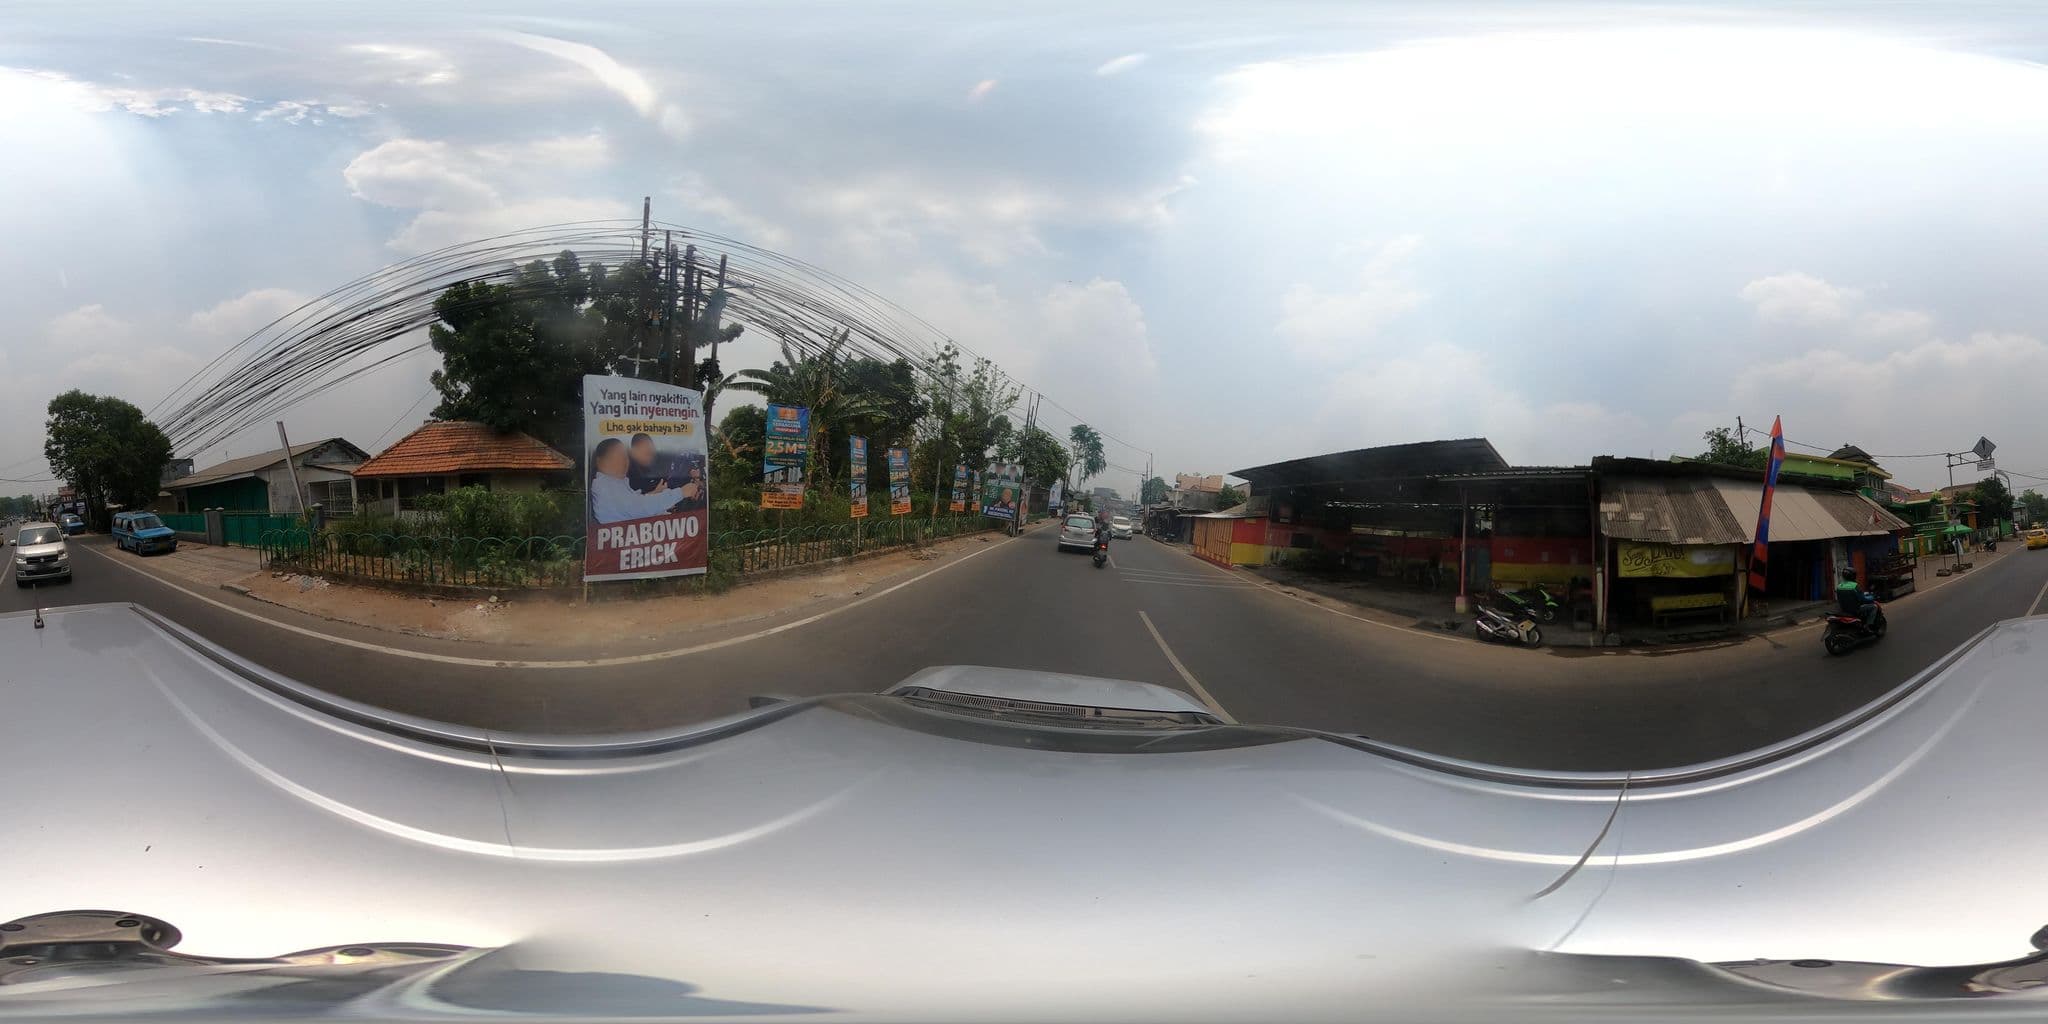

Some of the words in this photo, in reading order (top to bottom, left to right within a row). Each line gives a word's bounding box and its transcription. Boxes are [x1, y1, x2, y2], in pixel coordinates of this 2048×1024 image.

[600, 389, 627, 403] Yang
[629, 391, 647, 402] lain
[590, 402, 621, 417] Yang
[624, 403, 638, 415] ini
[641, 406, 700, 420] nyenengin.
[627, 424, 642, 434] gak
[643, 424, 672, 435] bahaya
[597, 516, 699, 550] PRABOWO
[619, 543, 678, 571] ERICK
